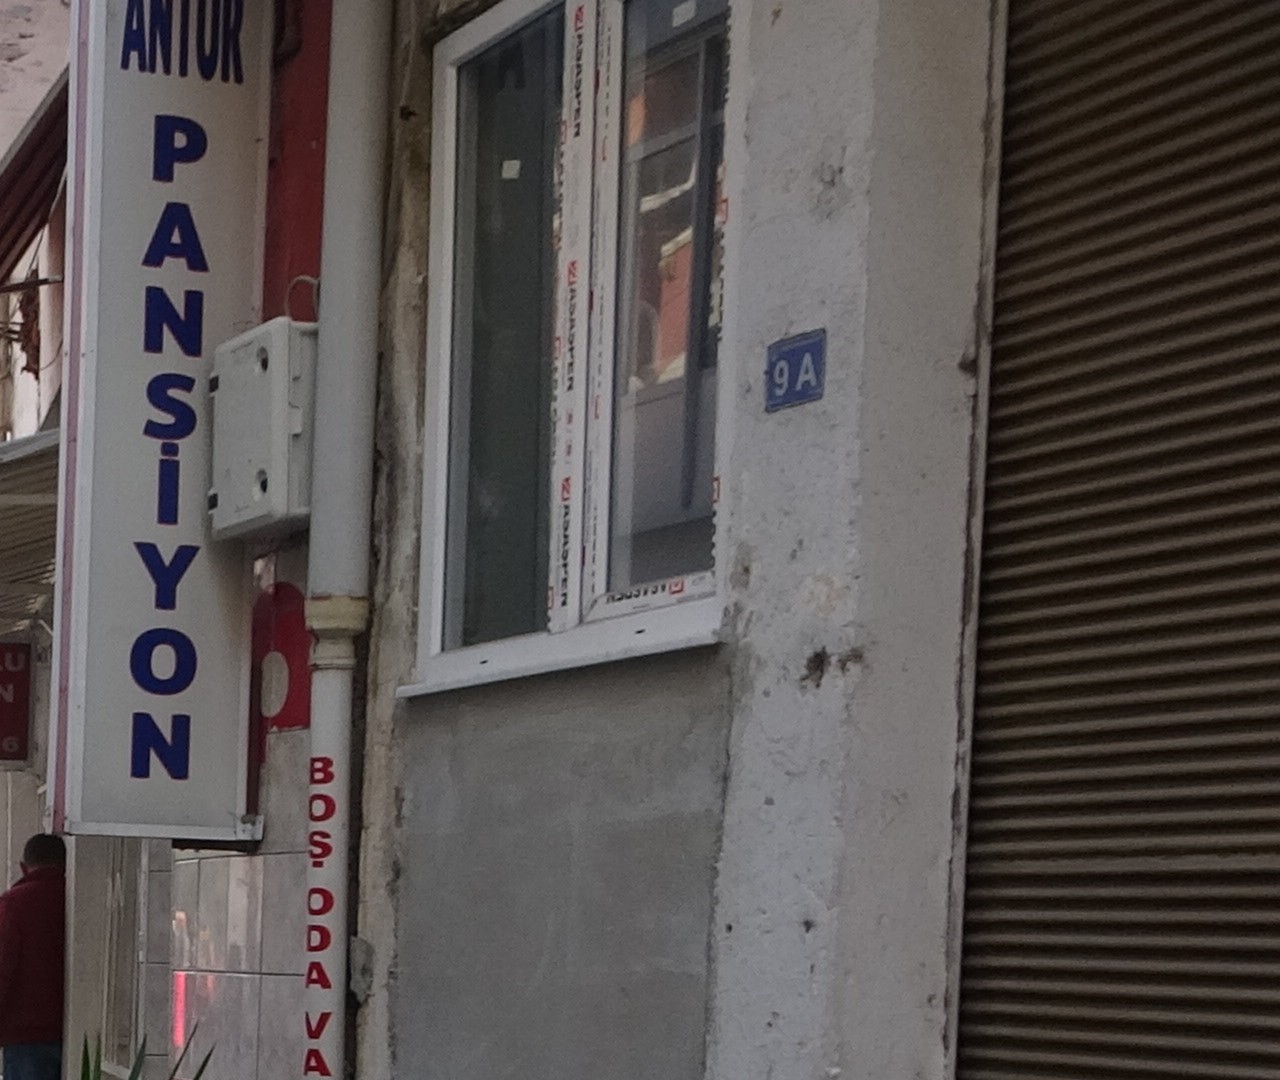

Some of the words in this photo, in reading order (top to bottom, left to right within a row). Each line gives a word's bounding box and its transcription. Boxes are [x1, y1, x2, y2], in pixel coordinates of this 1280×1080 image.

[773, 362, 788, 397] 9
[795, 357, 818, 390] A
[130, 115, 209, 780] PANSİYON
[308, 756, 336, 868] BOŞ
[305, 887, 334, 990] ODA
